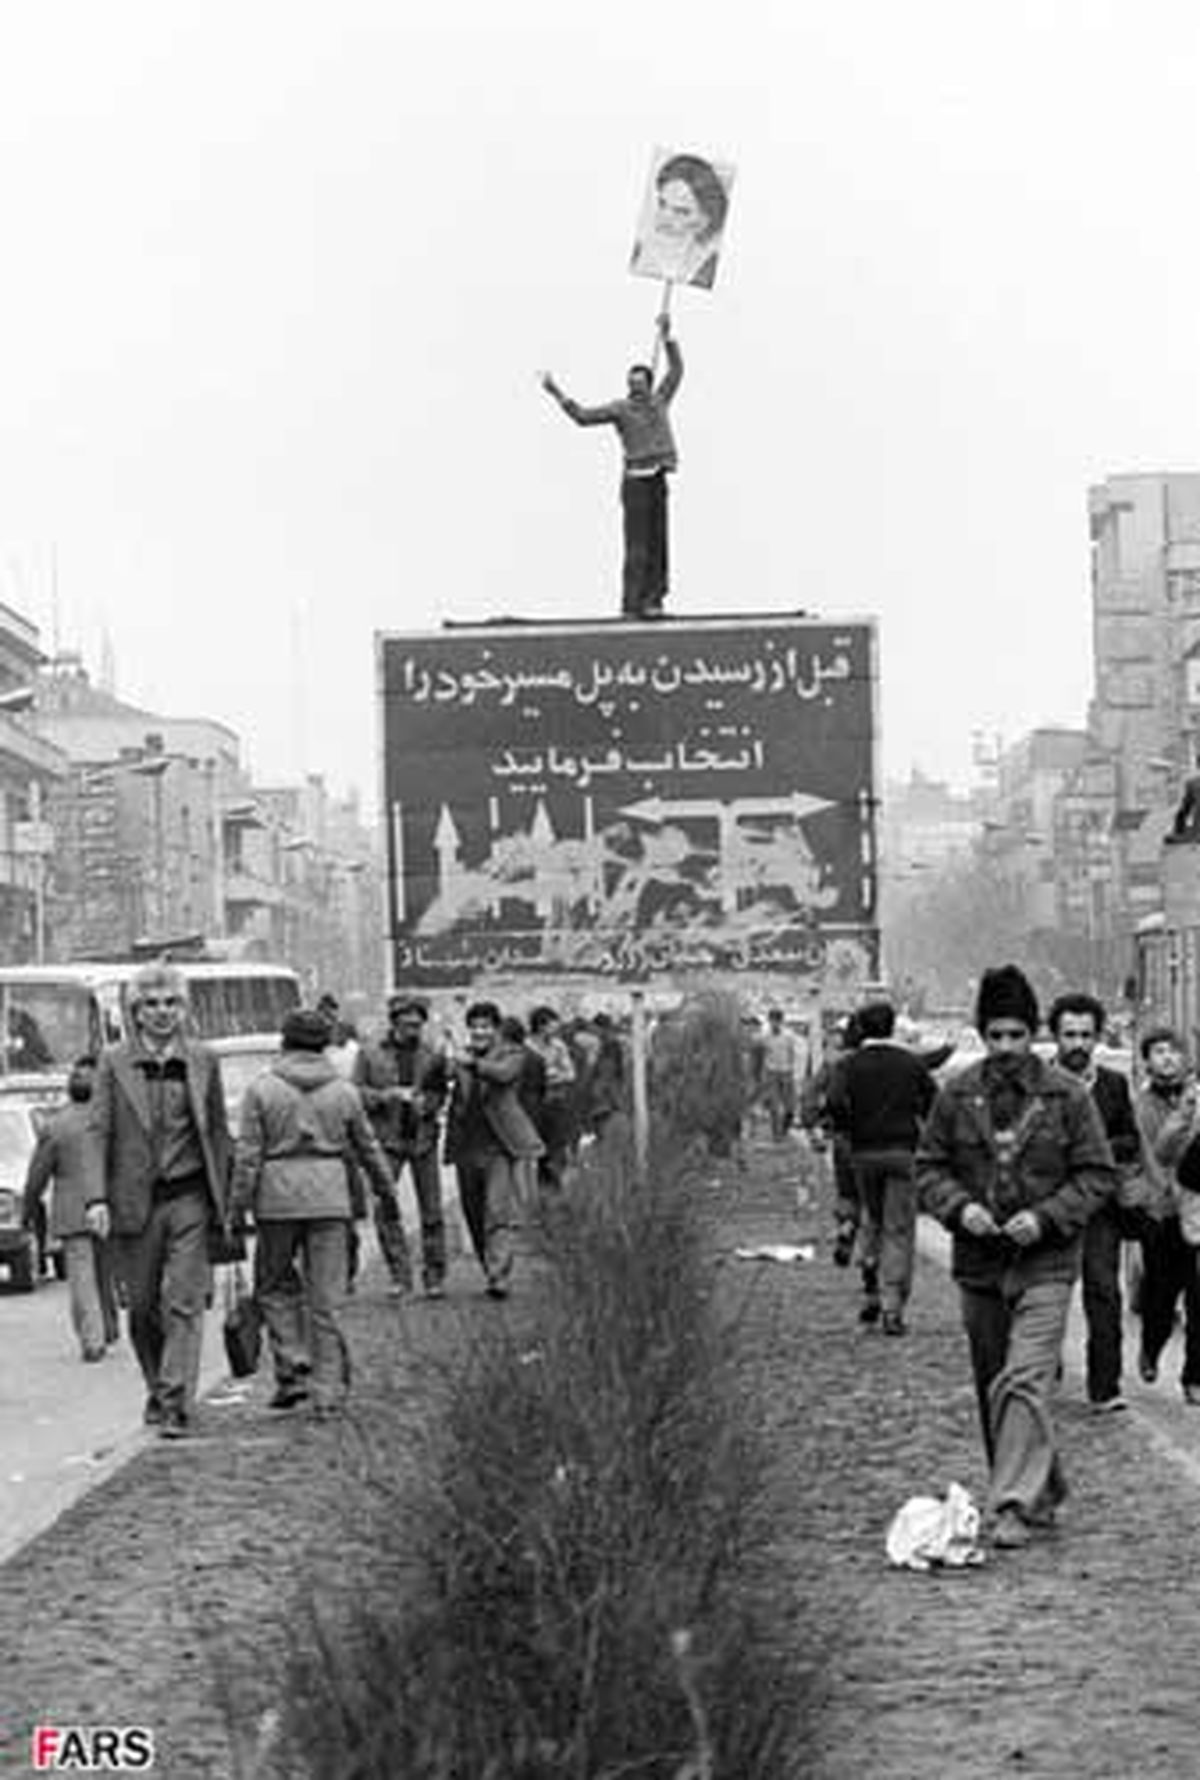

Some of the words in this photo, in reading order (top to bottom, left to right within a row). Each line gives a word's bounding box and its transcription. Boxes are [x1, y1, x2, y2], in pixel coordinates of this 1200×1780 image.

[403, 658, 432, 701] را
[433, 650, 501, 705] خود
[499, 669, 573, 718] مسیر
[574, 659, 616, 717] پل
[616, 660, 647, 712] به
[650, 655, 767, 710] رسیدن
[765, 640, 796, 693] از
[796, 637, 852, 707] قبل
[491, 728, 622, 793] فرمایید
[625, 726, 763, 790] انتخاب
